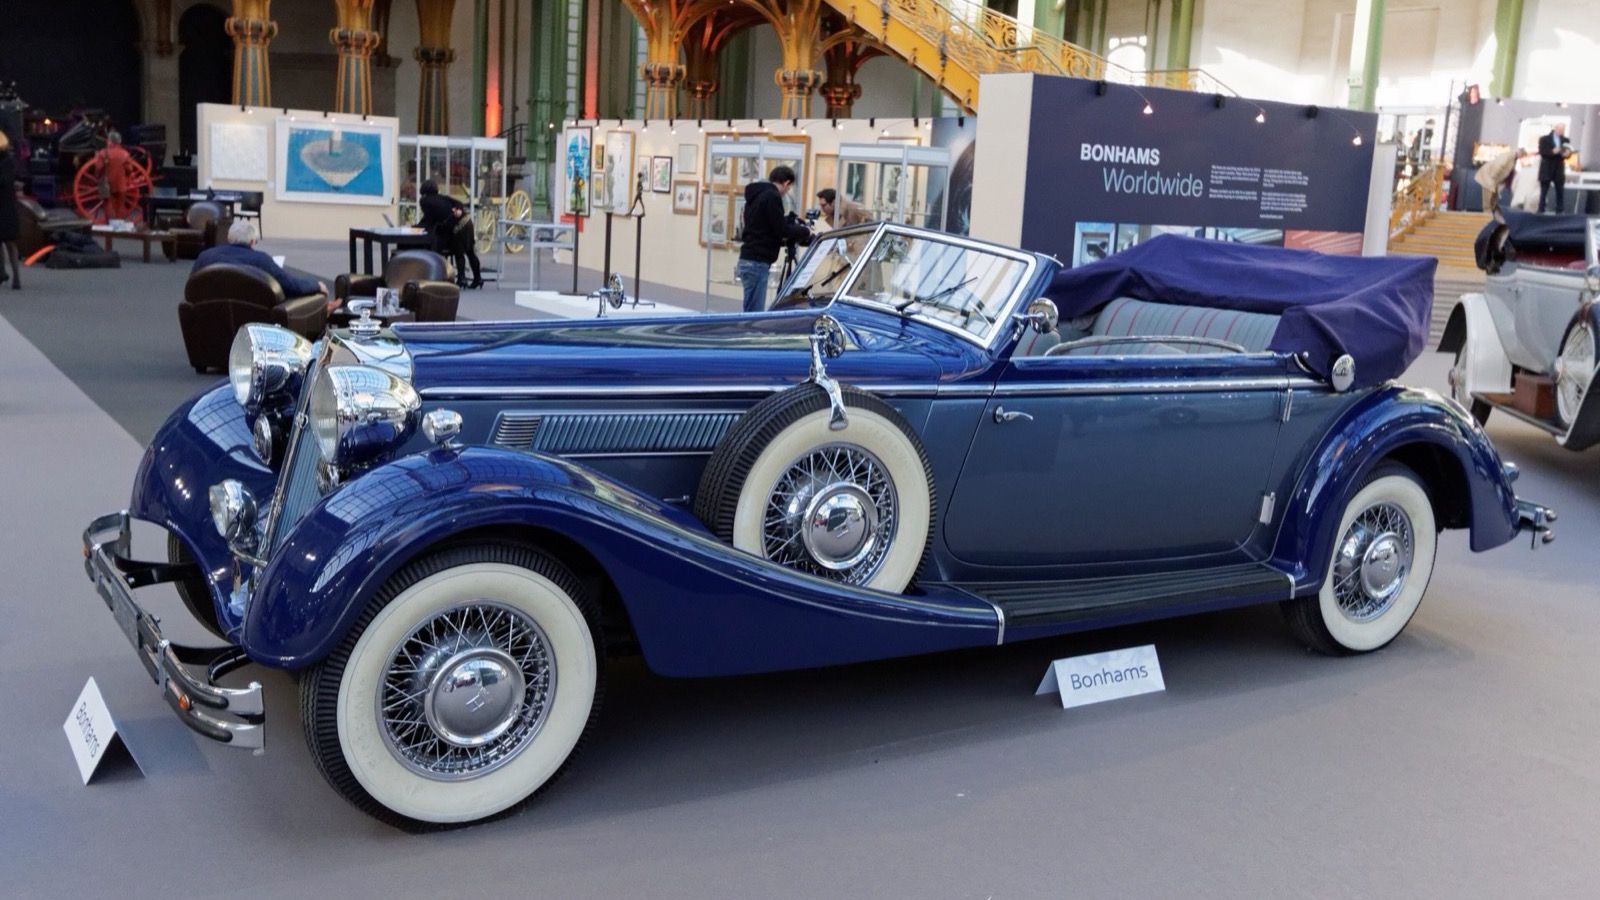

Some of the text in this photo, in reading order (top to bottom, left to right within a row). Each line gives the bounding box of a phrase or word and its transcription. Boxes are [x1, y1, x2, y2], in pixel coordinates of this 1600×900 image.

[1080, 143, 1160, 166] BONHAMS
[1103, 167, 1203, 197] Worldwide
[1070, 665, 1149, 690] Bonhams
[76, 701, 100, 758] Bonhams
